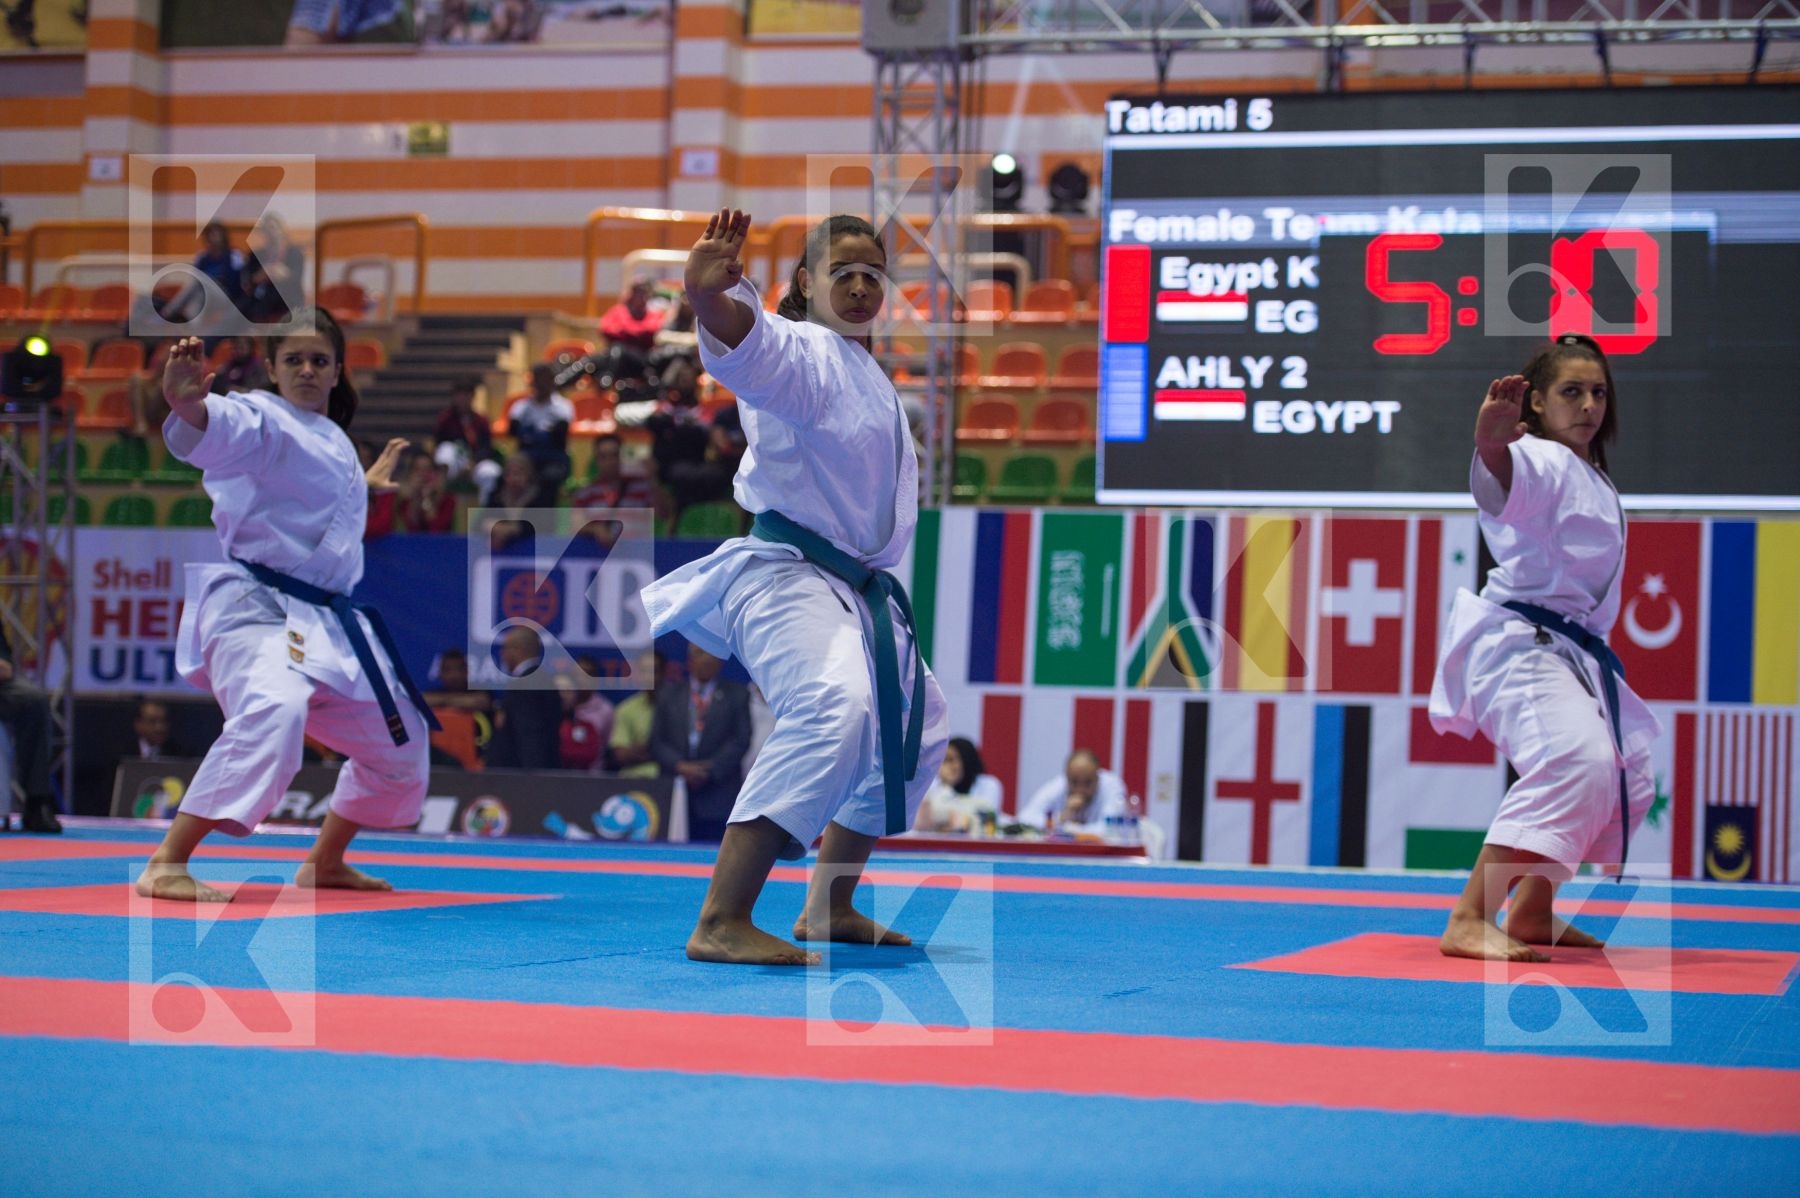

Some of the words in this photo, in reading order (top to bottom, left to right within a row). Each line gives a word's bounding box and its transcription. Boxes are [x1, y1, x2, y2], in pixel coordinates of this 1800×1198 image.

[1105, 98, 1237, 133] Tatami
[1246, 98, 1273, 131] 5
[1108, 208, 1255, 242] Female
[1263, 206, 1379, 241] Team
[1387, 205, 1483, 234] Kata
[1160, 256, 1279, 297] Egypt
[1286, 256, 1320, 289] K
[1255, 299, 1320, 333] EG
[1155, 355, 1274, 389] AHLY
[1280, 355, 1308, 389] 2
[1253, 400, 1401, 435] EGYPT
[93, 557, 172, 590] Shell
